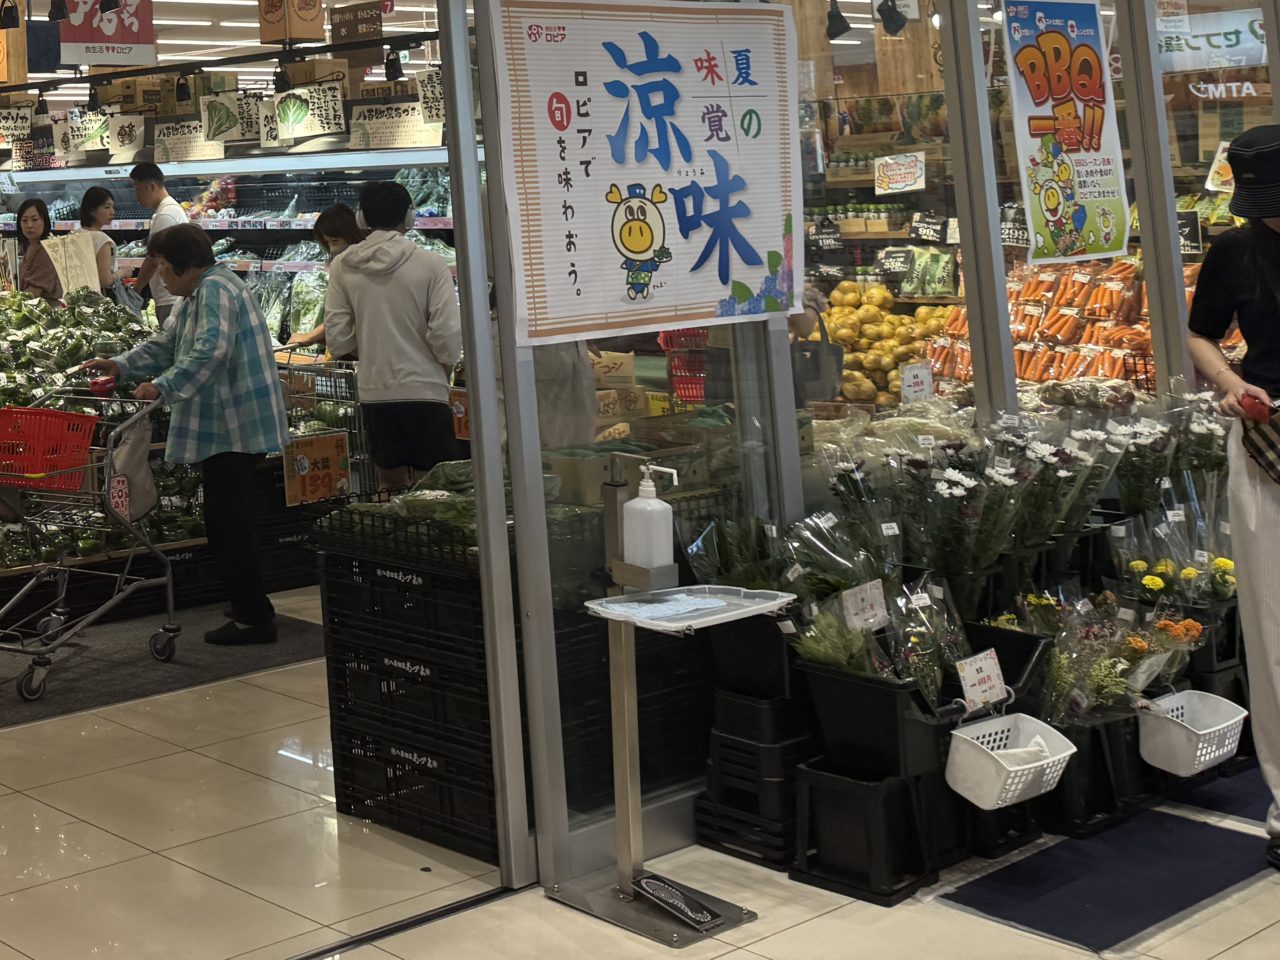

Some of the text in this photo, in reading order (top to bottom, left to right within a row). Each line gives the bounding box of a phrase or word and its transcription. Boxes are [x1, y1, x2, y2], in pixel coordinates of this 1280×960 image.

[384, 1, 391, 14] 7
[85, 45, 133, 55] 食生活 ロピア
[545, 33, 567, 43] ロピア
[1014, 30, 1106, 107] BBQ
[327, 86, 343, 130] サニーレタス
[574, 71, 596, 178] ロピアで
[1028, 98, 1105, 154] 一番!!
[676, 167, 705, 177] りょうみ
[547, 91, 582, 297] 旬を味わおう。
[1001, 228, 1029, 240] 299
